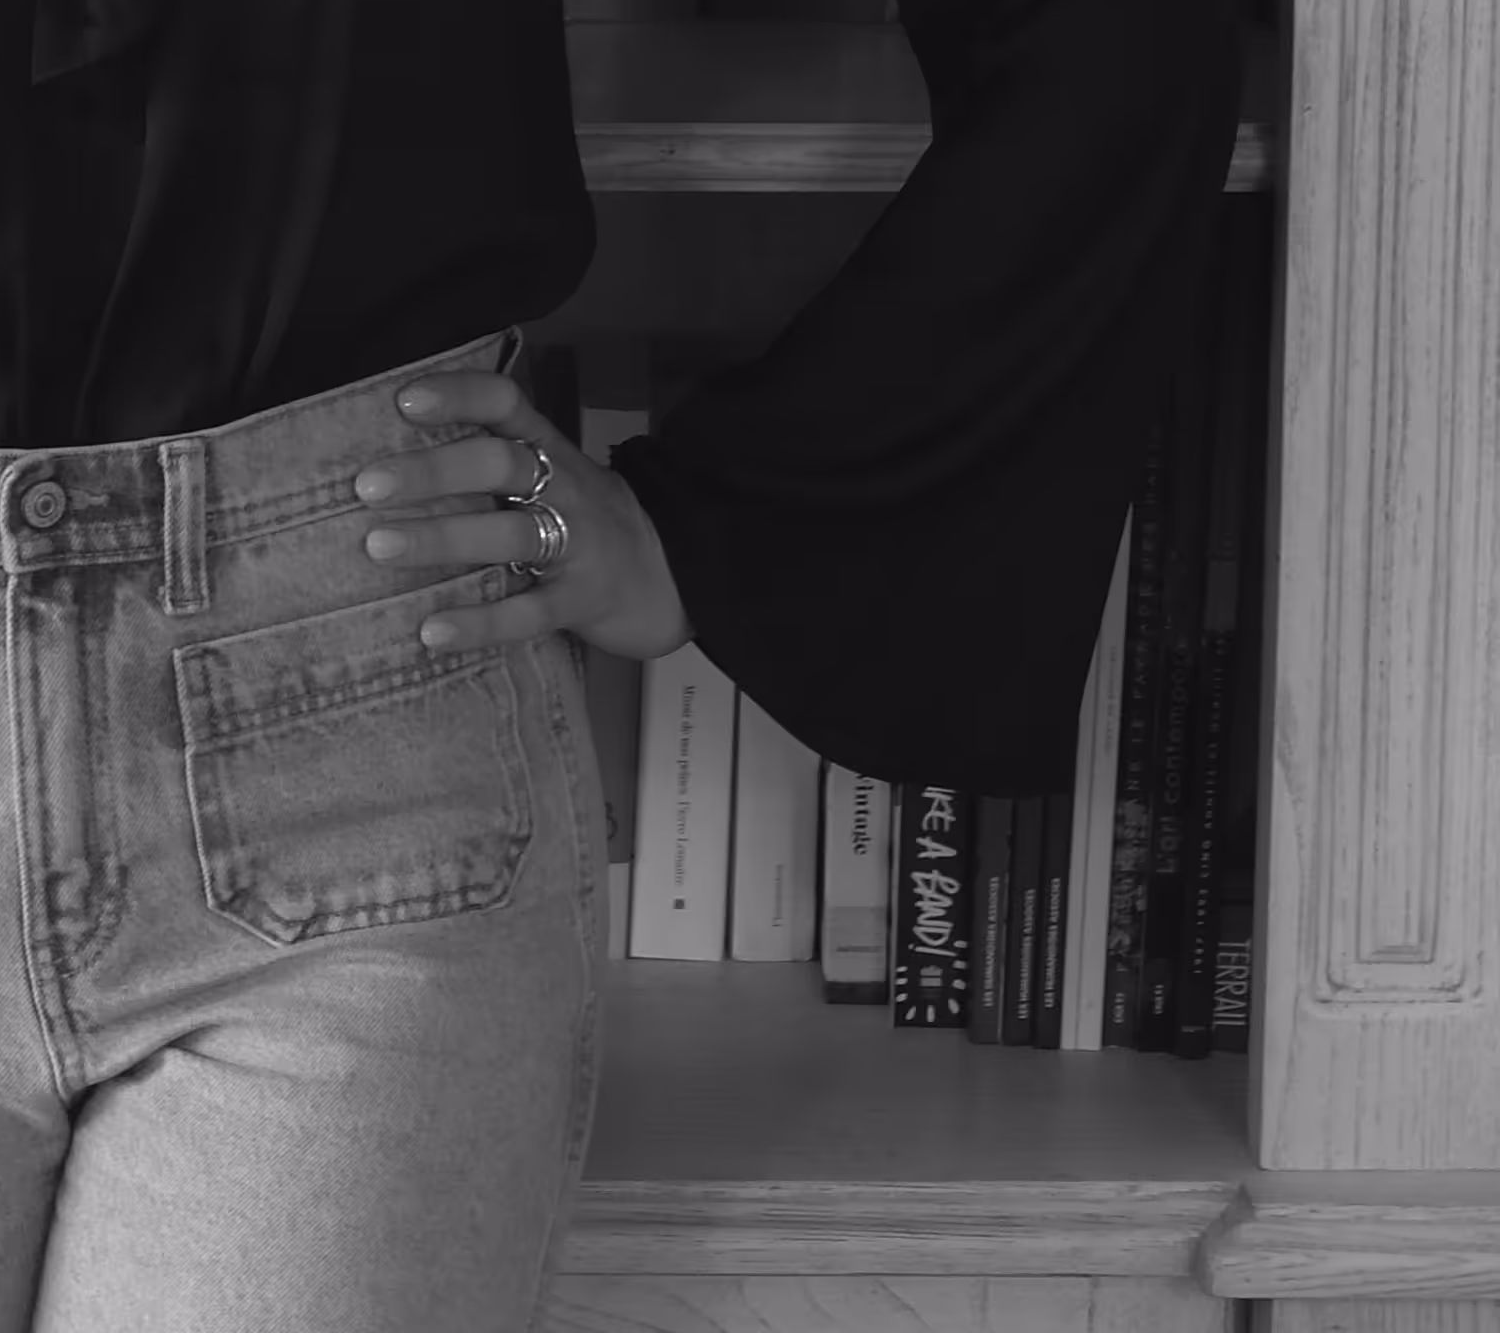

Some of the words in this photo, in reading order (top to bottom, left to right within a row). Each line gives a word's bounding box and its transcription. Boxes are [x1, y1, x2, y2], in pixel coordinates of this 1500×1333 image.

[915, 836, 958, 859] A
[1156, 808, 1178, 874] L'art
[1211, 937, 1251, 1030] TERRAIL
